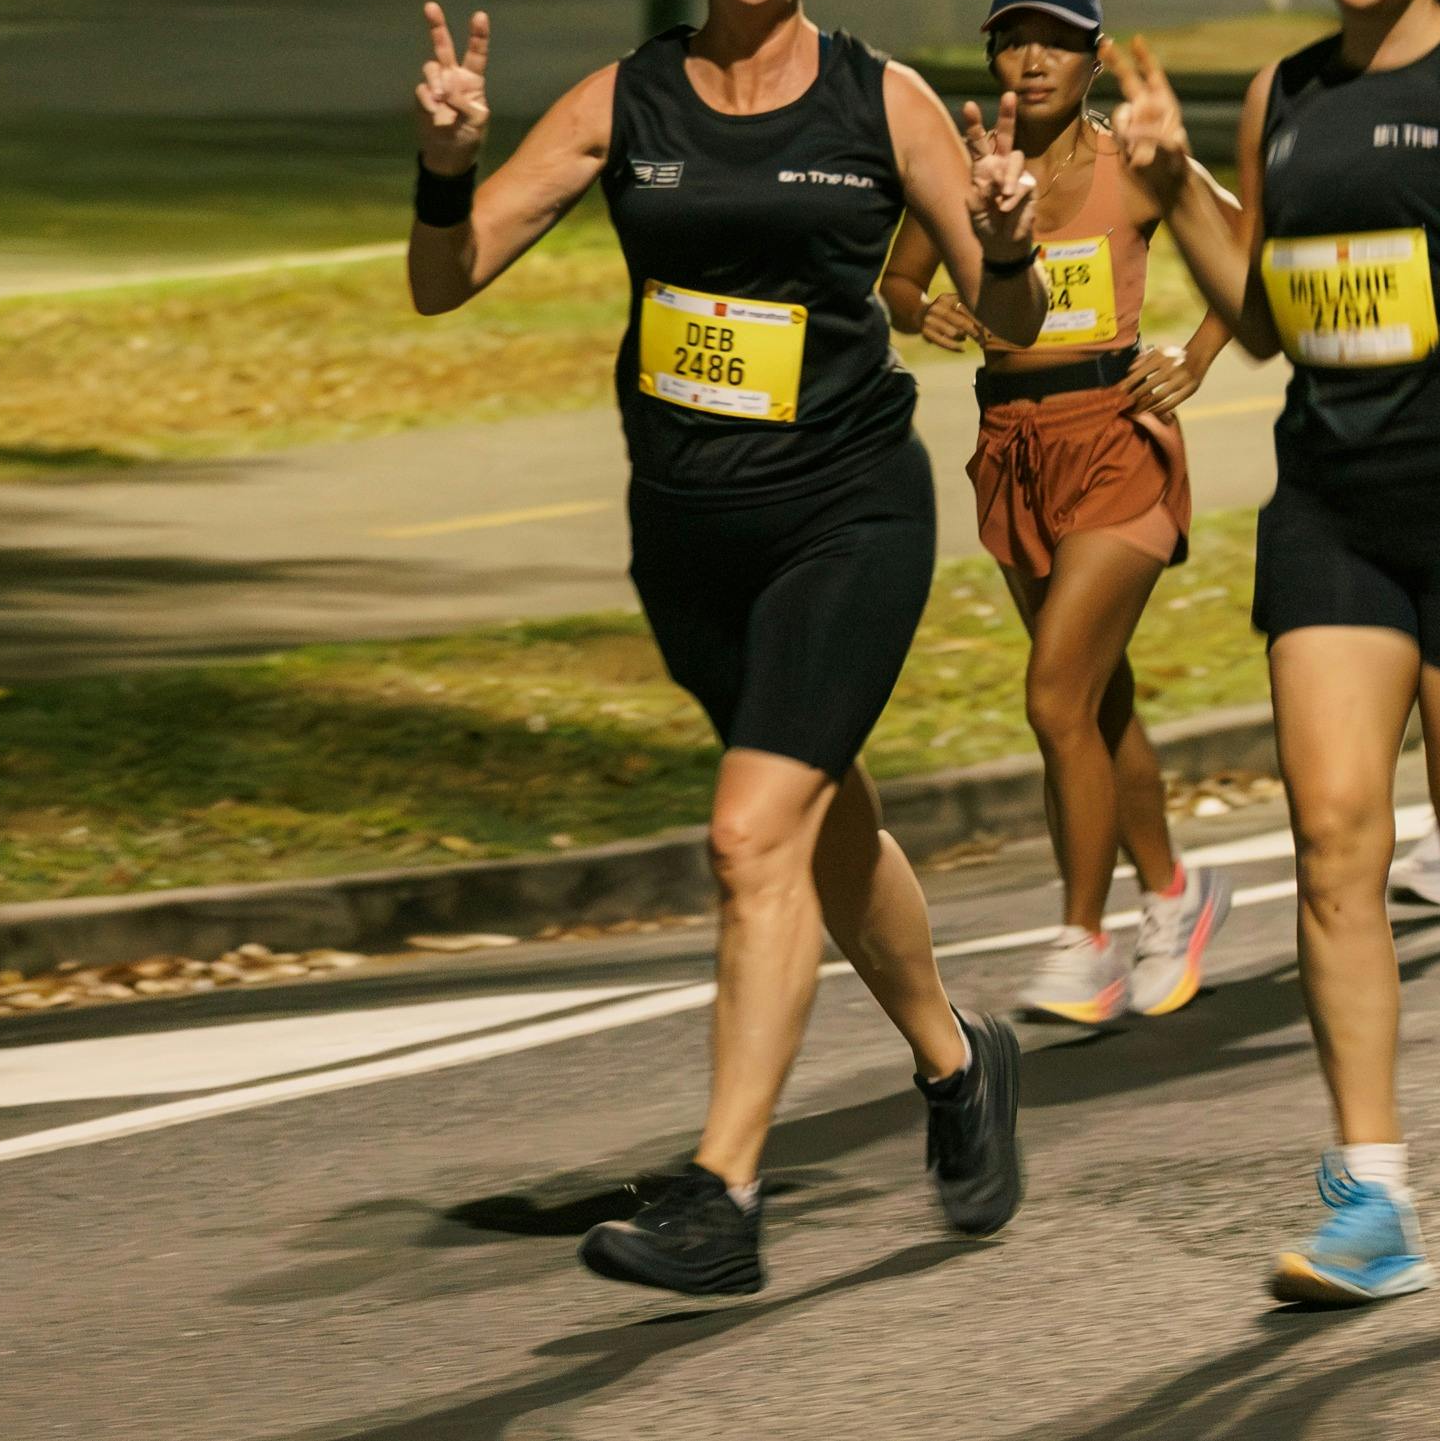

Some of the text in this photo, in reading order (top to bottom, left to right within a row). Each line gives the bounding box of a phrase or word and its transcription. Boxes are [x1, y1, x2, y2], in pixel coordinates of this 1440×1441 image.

[1290, 265, 1398, 305] MELANIE
[686, 322, 734, 353] DEB
[674, 347, 746, 386] 2486
